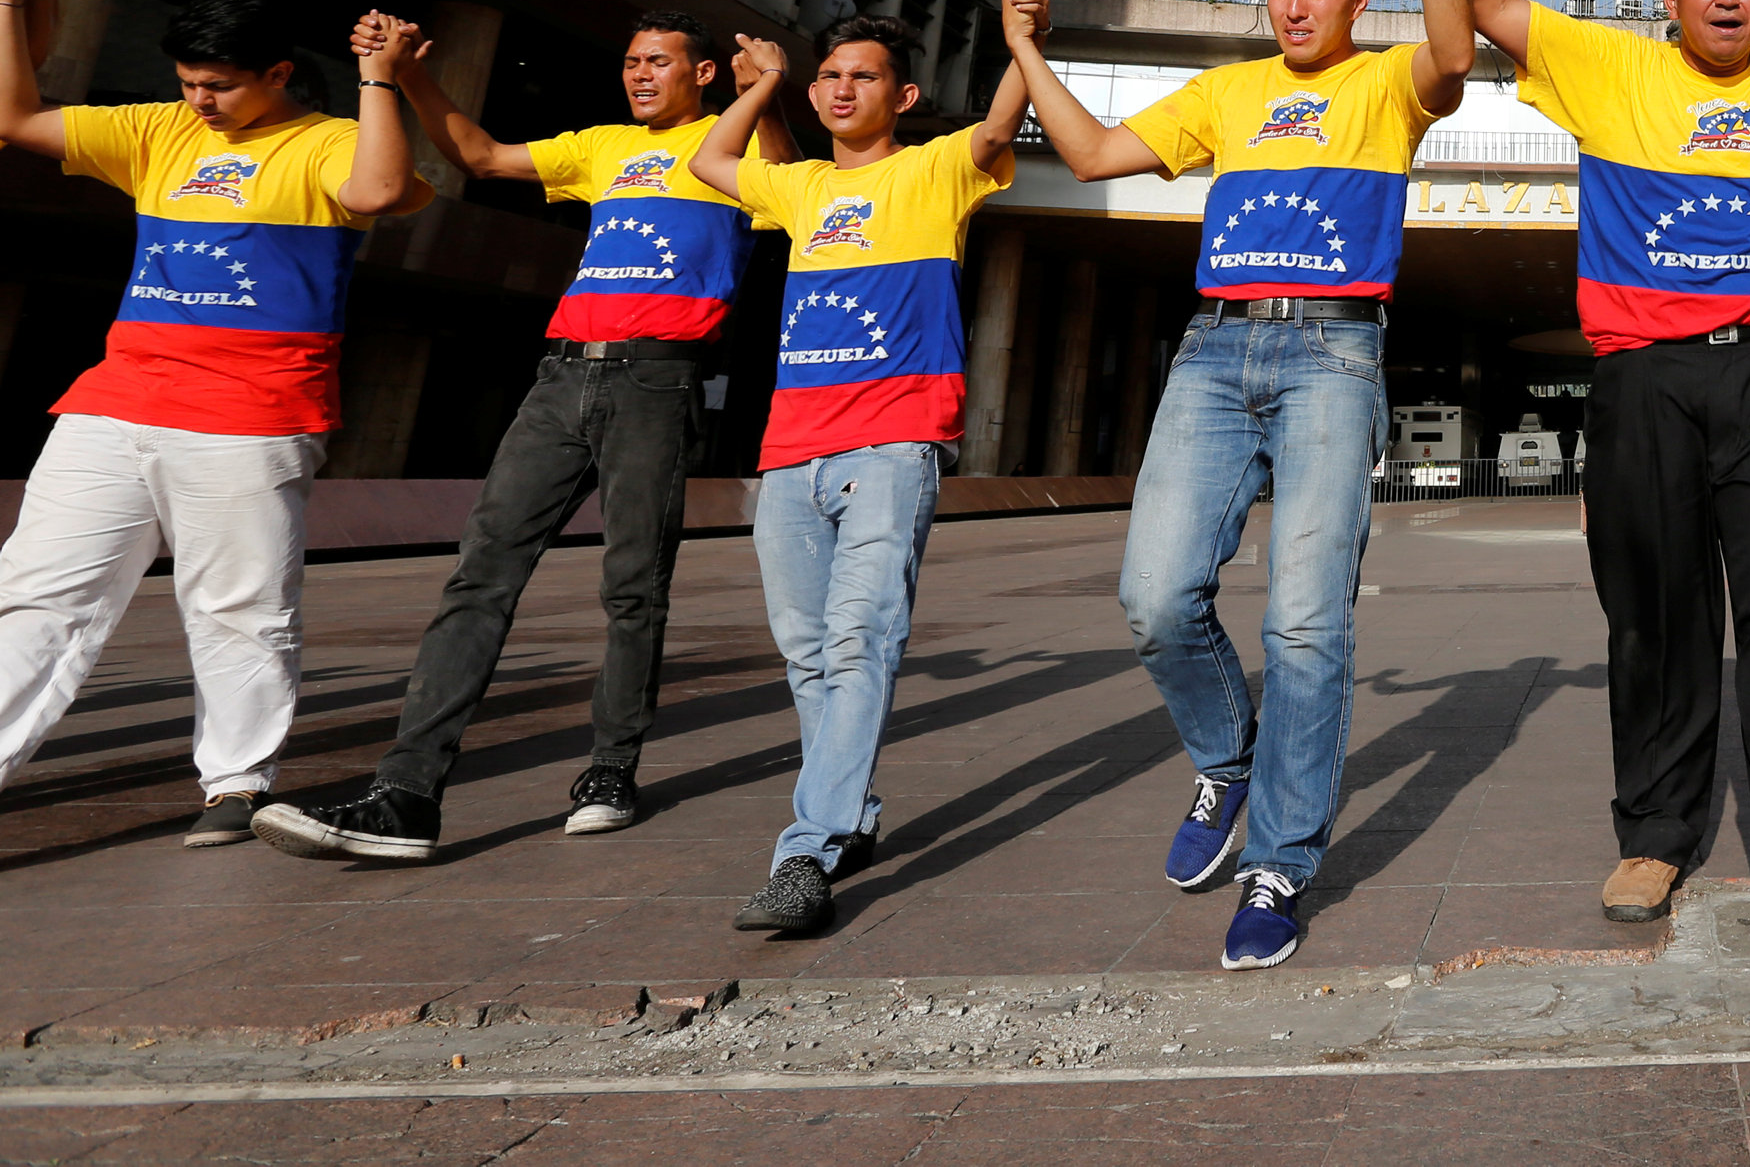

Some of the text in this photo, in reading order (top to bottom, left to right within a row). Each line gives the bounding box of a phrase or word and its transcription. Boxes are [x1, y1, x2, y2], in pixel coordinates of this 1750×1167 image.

[1686, 98, 1748, 117] Venezua
[1418, 180, 1575, 213] LAZA
[1210, 251, 1347, 273] VENEZUELA
[576, 266, 675, 282] ENEZUELA
[131, 285, 258, 306] VENZUELA
